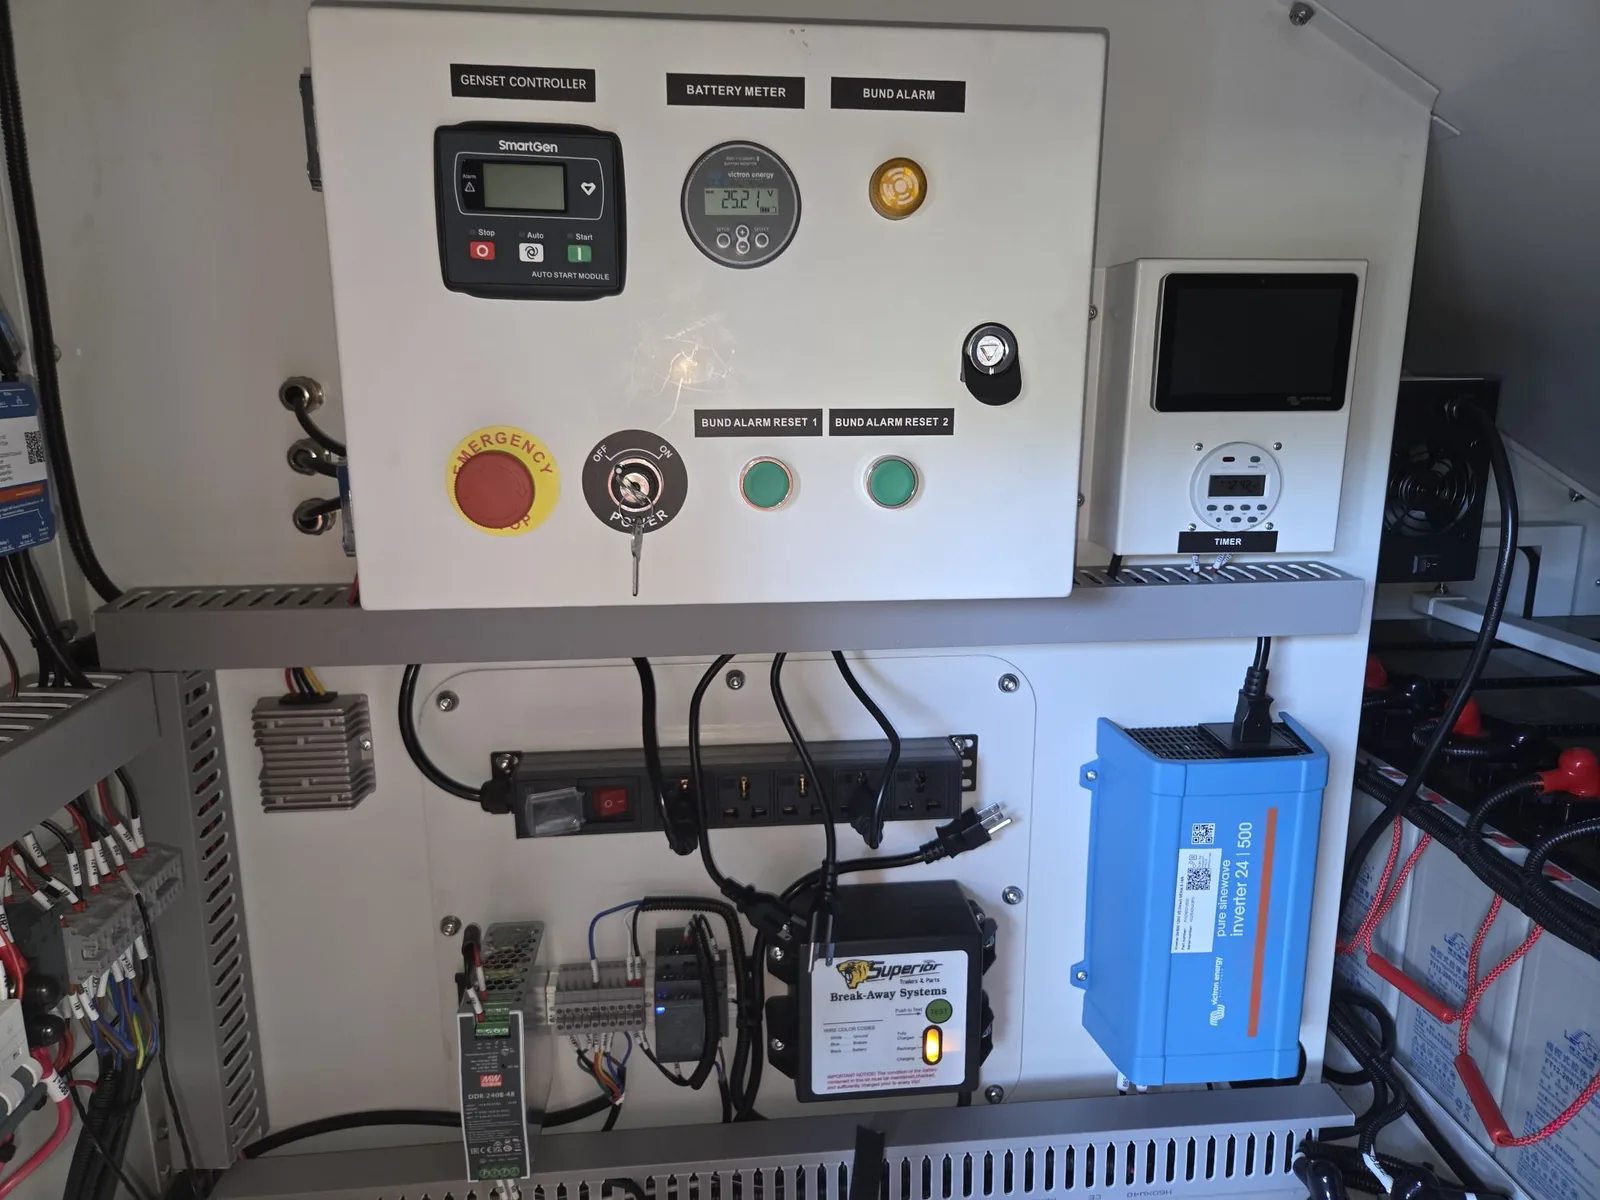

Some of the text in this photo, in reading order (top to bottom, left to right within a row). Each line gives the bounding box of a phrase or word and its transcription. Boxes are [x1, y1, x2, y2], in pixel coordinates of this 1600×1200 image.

[460, 74, 587, 90] GENSET CONTROLLER
[686, 84, 787, 98] BATTERY METER
[863, 88, 936, 100] BUND ALARM
[498, 140, 558, 153] SmartGen
[728, 170, 750, 179] victron
[478, 229, 496, 237] Stop
[575, 233, 593, 241] Start
[701, 417, 818, 427] BUND ALARM RESET 1
[835, 417, 949, 427] BUND ALARM RESET 2
[592, 444, 608, 462] OFF
[659, 445, 673, 458] ON
[1237, 822, 1253, 848] 500
[1234, 860, 1250, 878] 24
[1217, 859, 1231, 937] pure sinewave
[1230, 882, 1248, 936] inverter
[866, 959, 943, 980] Superior
[1214, 957, 1223, 980] energy
[830, 987, 947, 1001] Break-Away Systems
[1211, 982, 1219, 1005] victron
